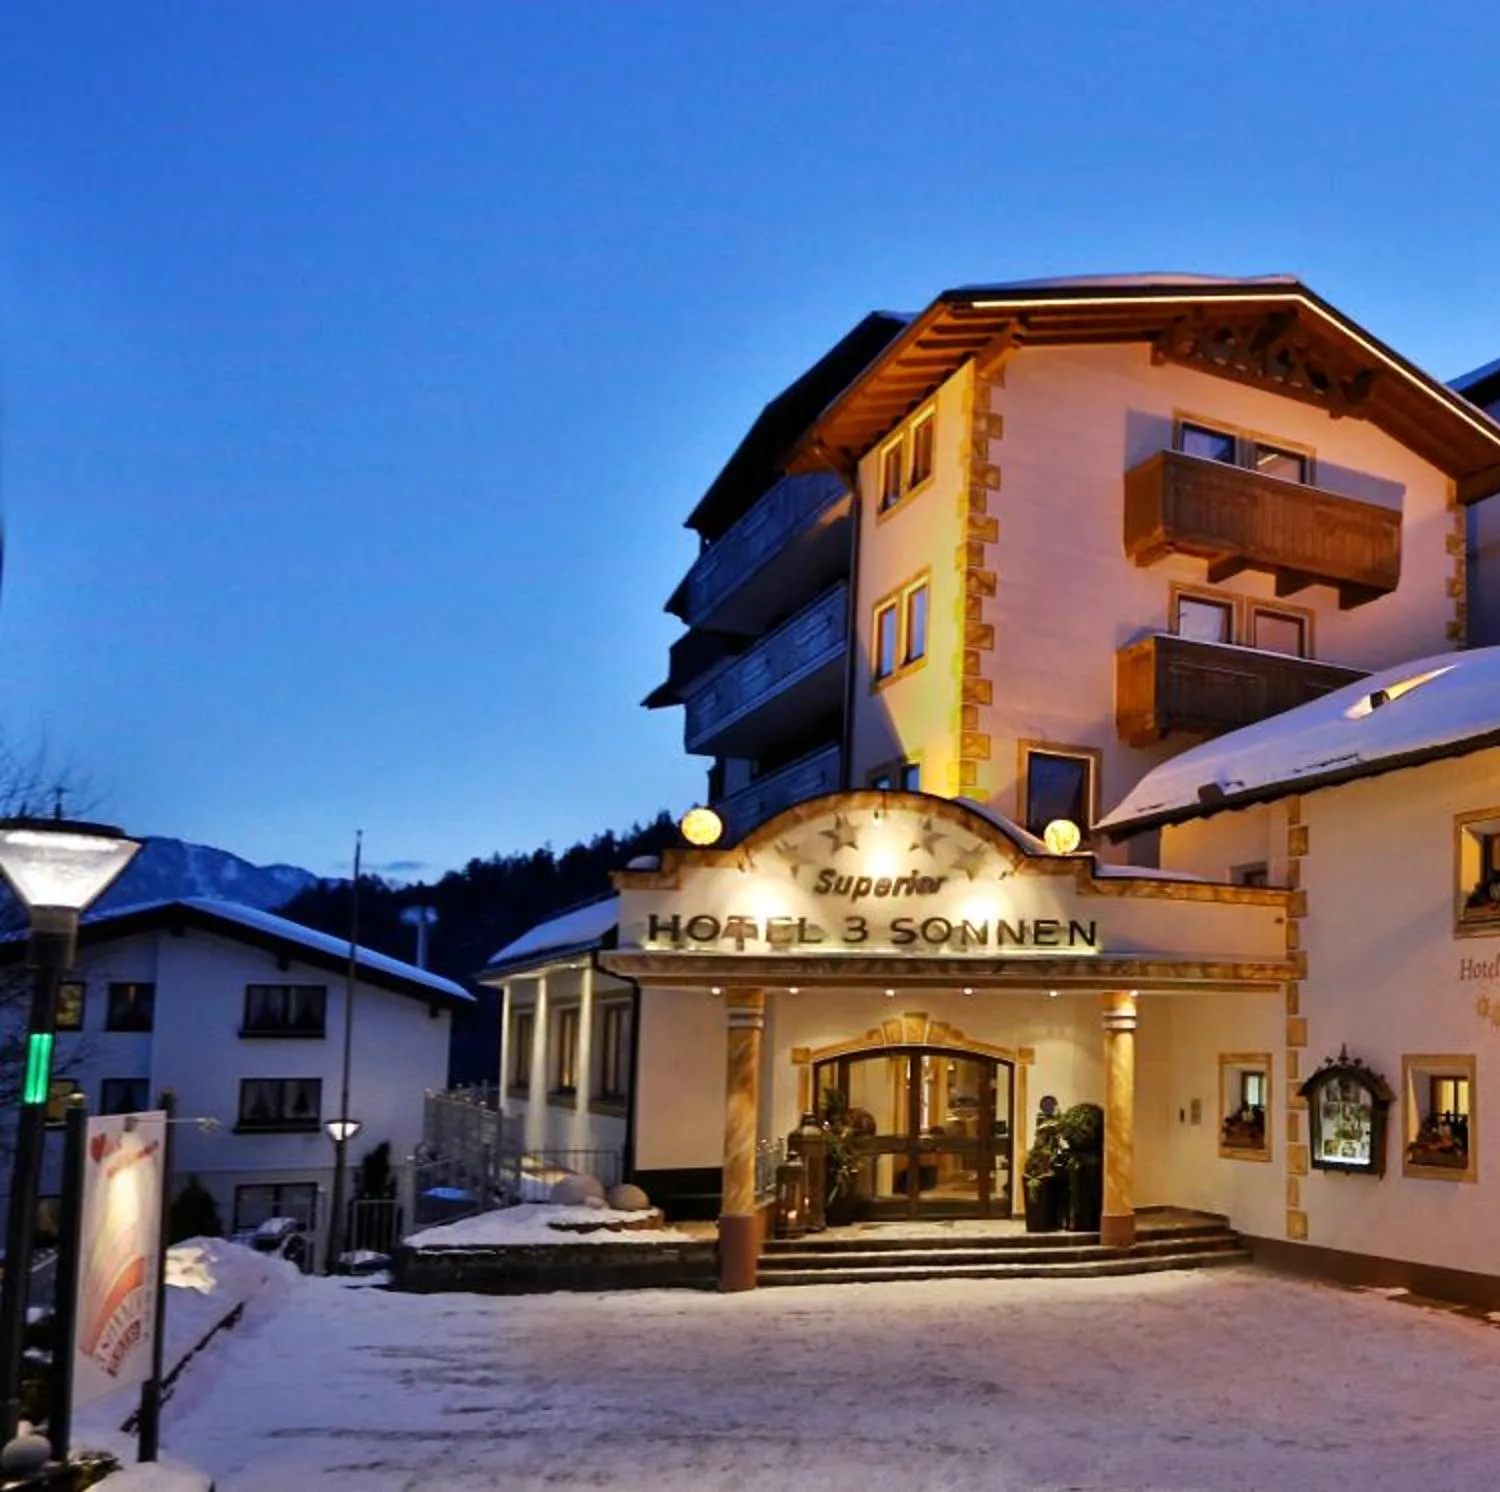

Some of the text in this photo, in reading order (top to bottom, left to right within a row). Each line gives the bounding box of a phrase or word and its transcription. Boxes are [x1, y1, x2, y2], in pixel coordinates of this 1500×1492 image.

[814, 867, 947, 903] Superior
[648, 913, 1097, 948] HOTEL 3 SONNEN
